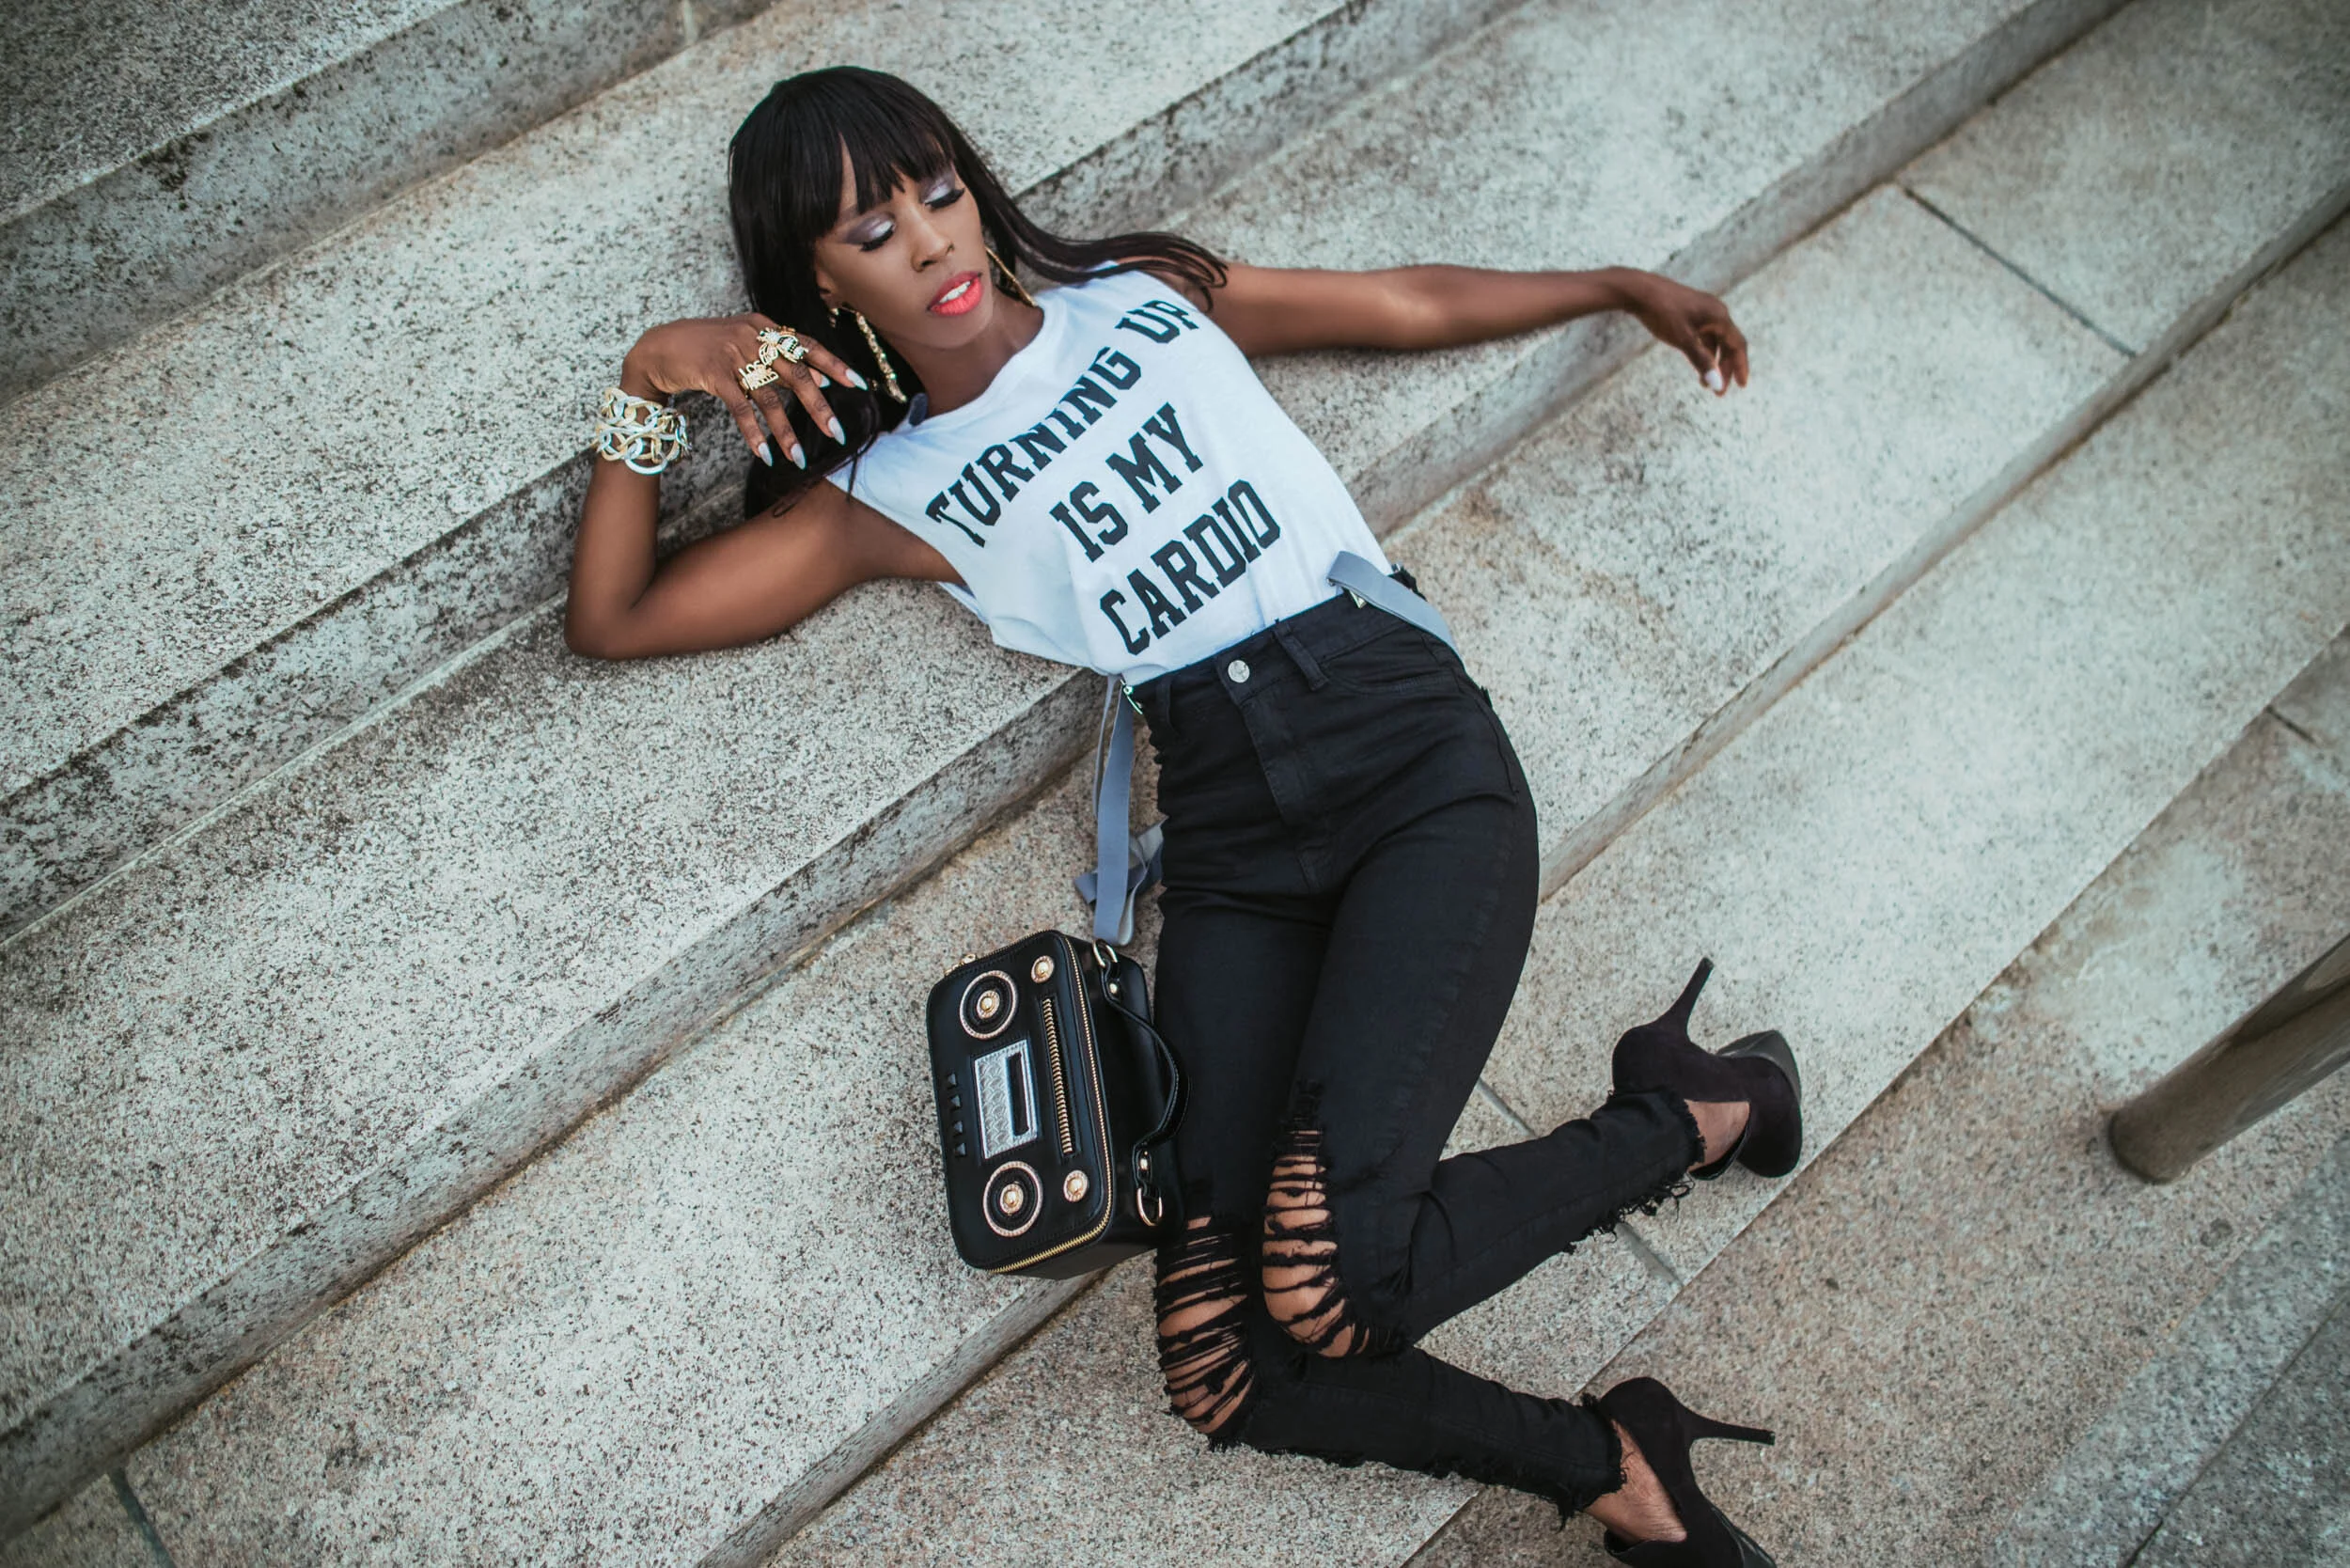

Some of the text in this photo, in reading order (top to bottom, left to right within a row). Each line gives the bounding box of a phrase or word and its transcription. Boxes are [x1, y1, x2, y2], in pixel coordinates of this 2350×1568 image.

[925, 300, 1199, 548] TURNING UP
[1049, 401, 1203, 563] IS MY
[1100, 479, 1281, 655] CARDIO
